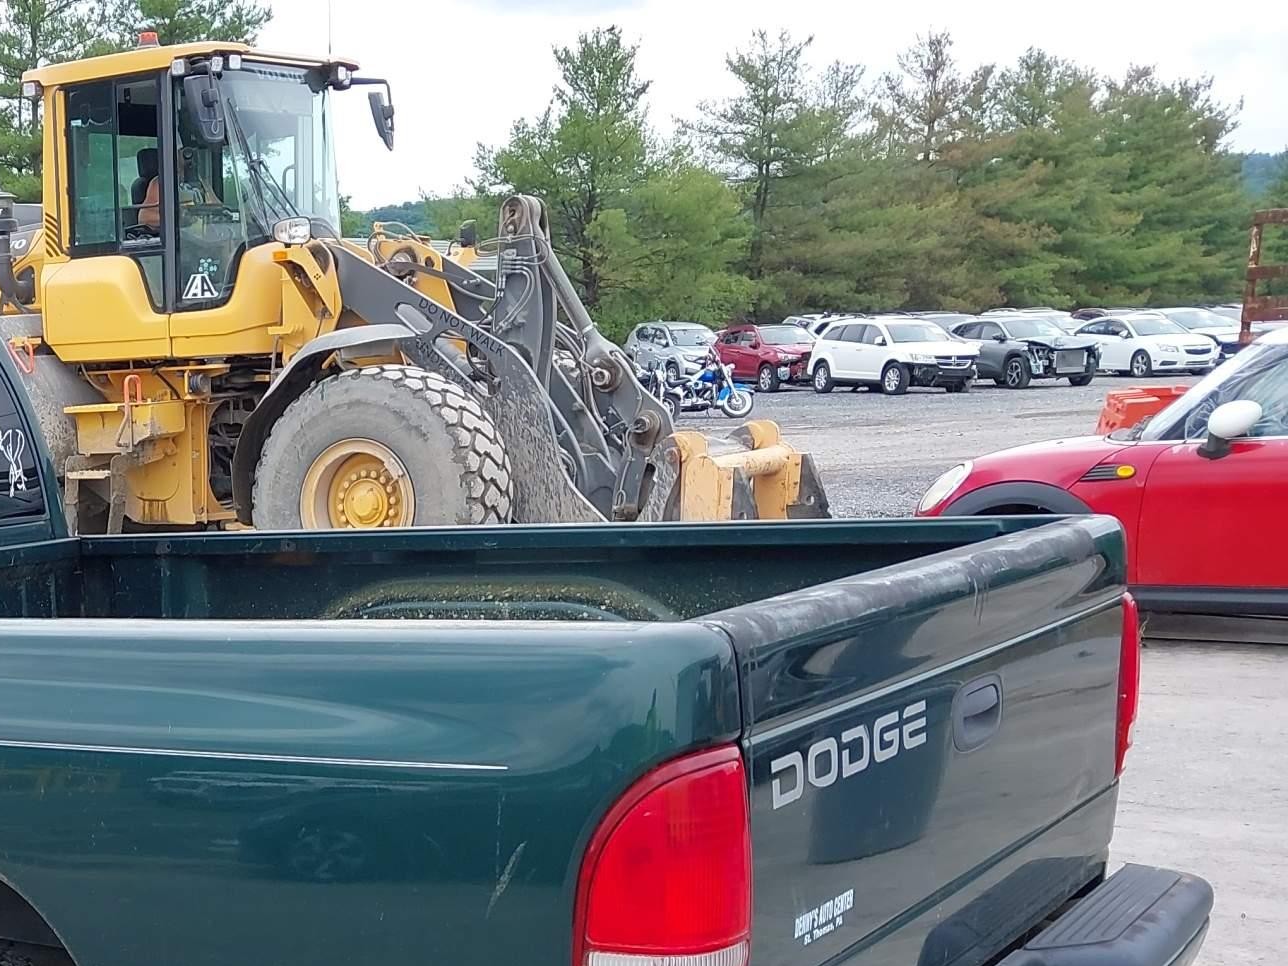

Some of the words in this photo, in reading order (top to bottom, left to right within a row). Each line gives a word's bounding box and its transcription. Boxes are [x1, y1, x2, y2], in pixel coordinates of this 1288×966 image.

[419, 297, 438, 314] DO
[439, 311, 466, 330] NOT
[470, 327, 506, 356] WALK
[771, 700, 927, 810] DODGE
[794, 908, 819, 939] DENNY'S
[819, 899, 834, 926] AUTO
[833, 888, 854, 918] CENTER
[836, 915, 843, 928] PA
